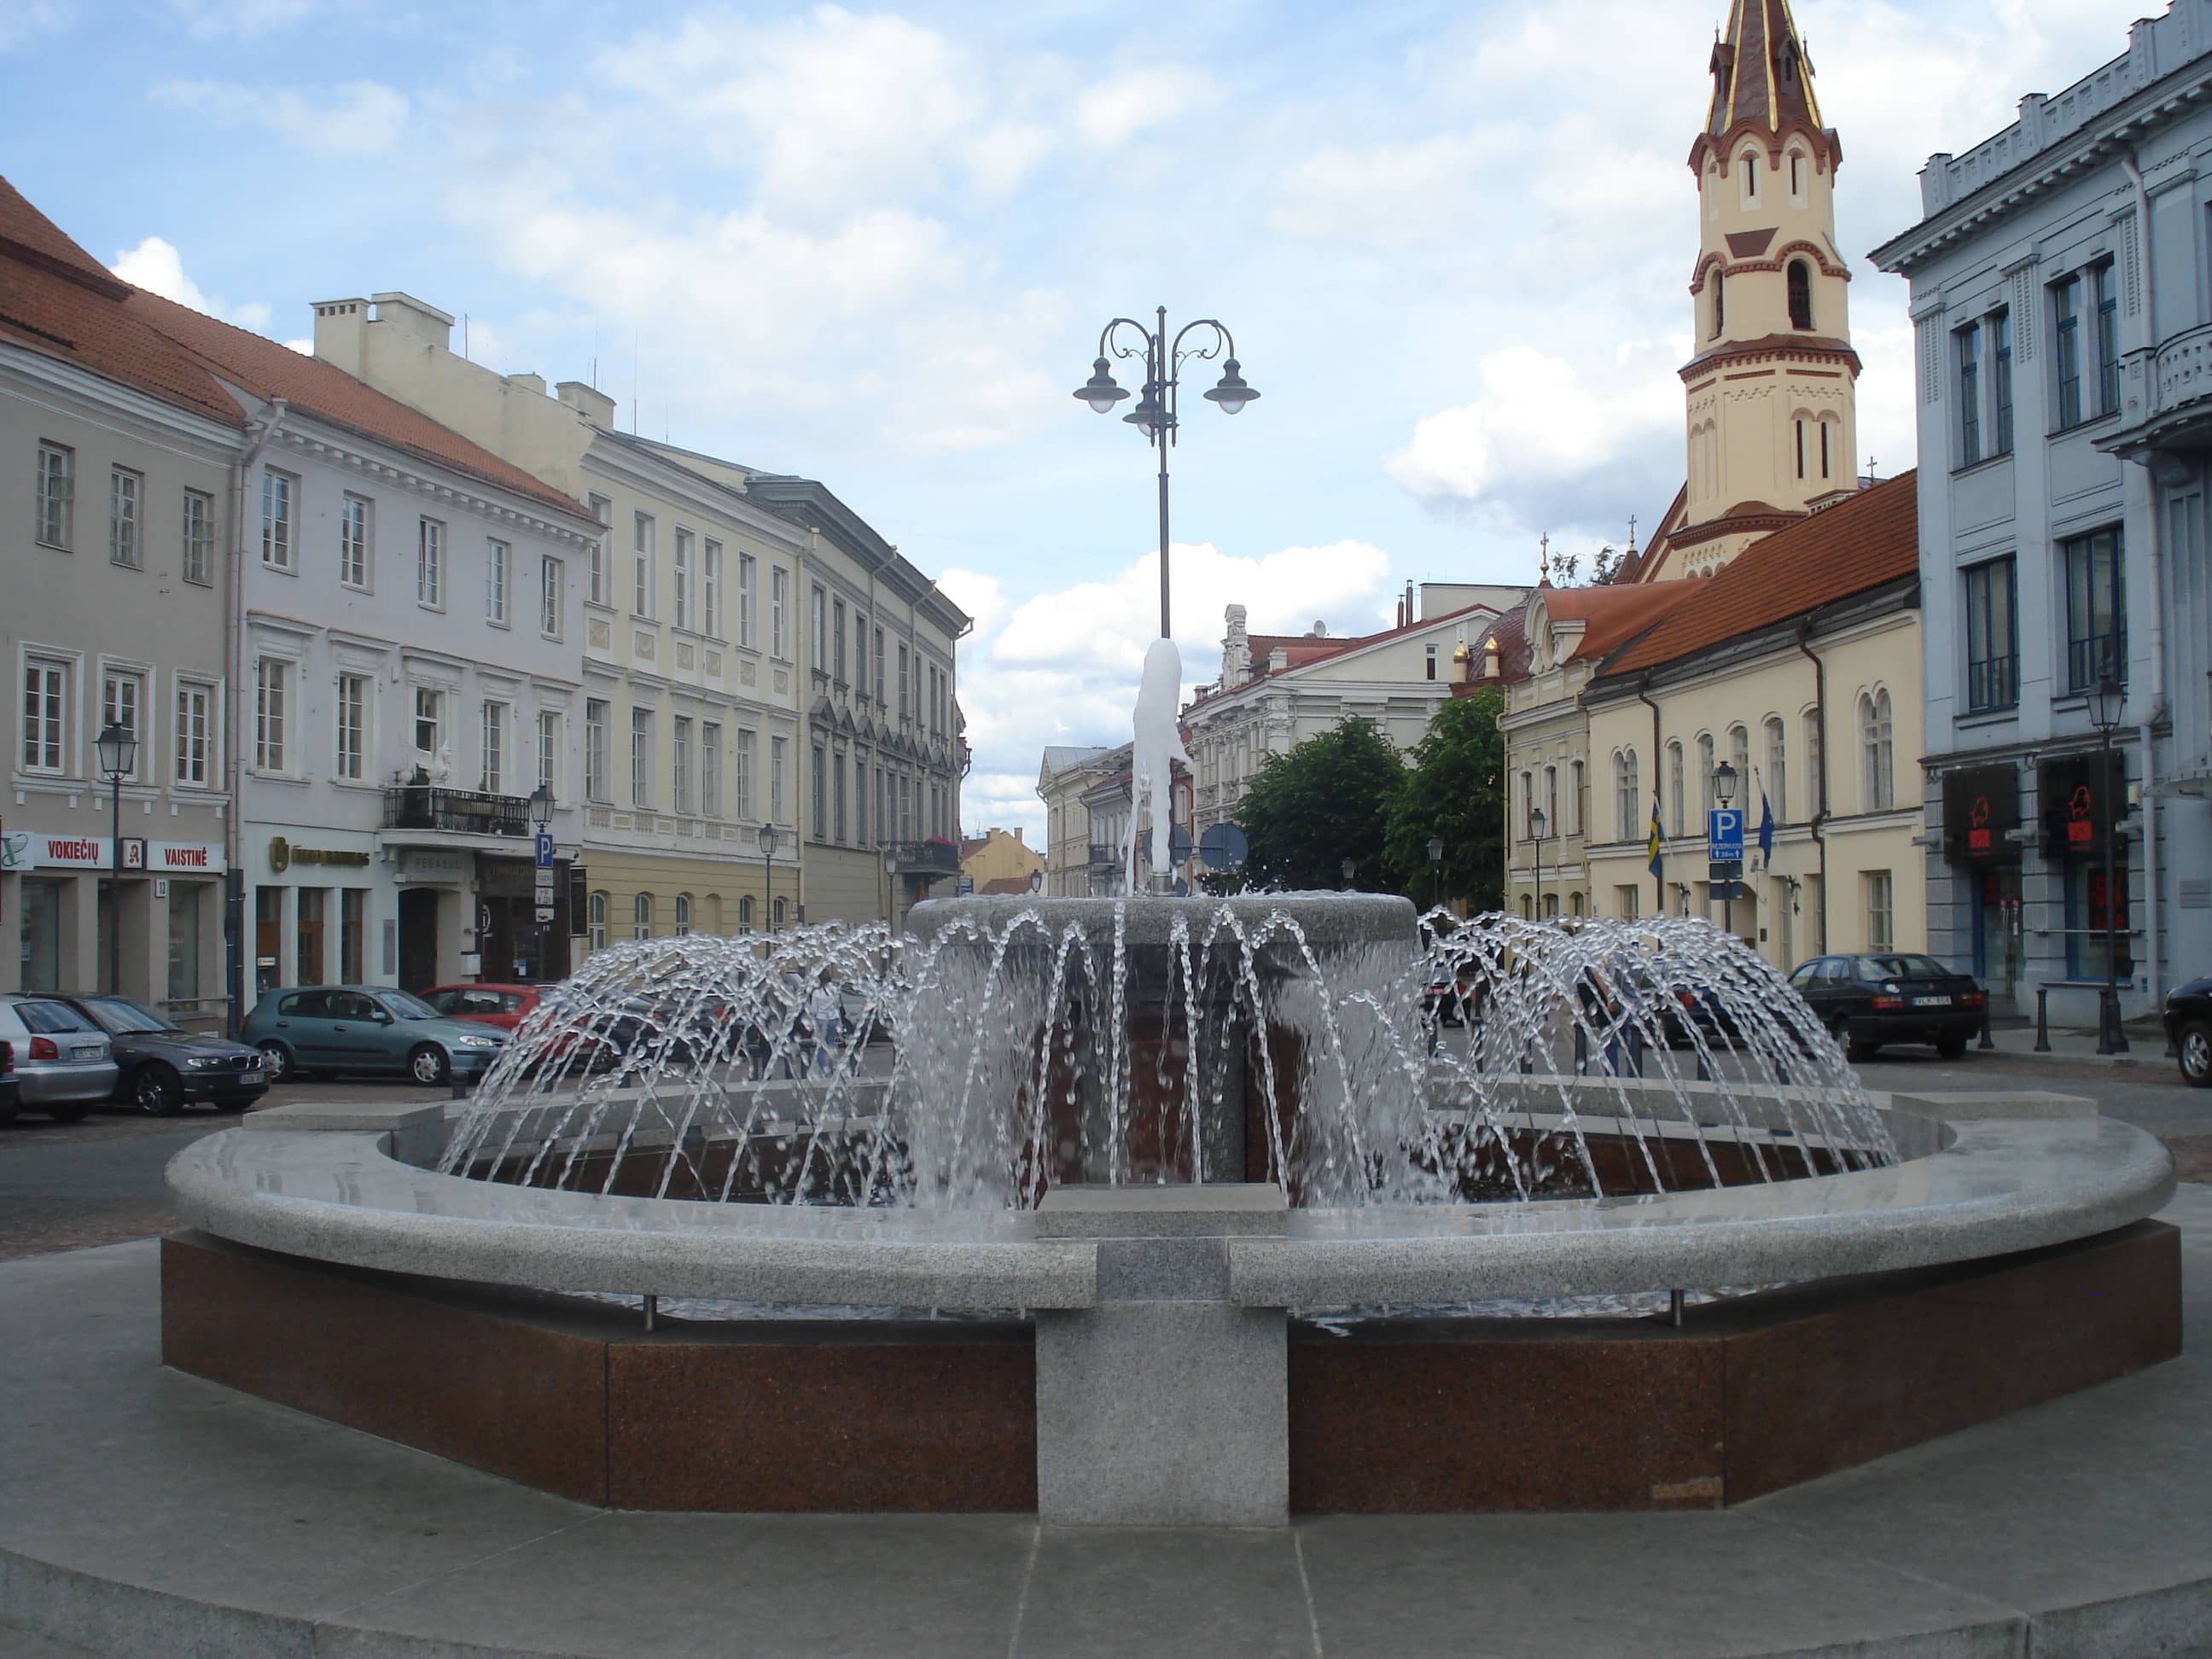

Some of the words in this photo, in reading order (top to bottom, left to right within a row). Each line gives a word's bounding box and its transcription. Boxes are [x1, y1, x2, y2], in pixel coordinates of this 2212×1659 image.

[1717, 812, 1737, 841] P
[48, 839, 99, 865] VOKIEČIŲ
[165, 847, 207, 867] VAISTINĖ
[540, 836, 550, 864] P
